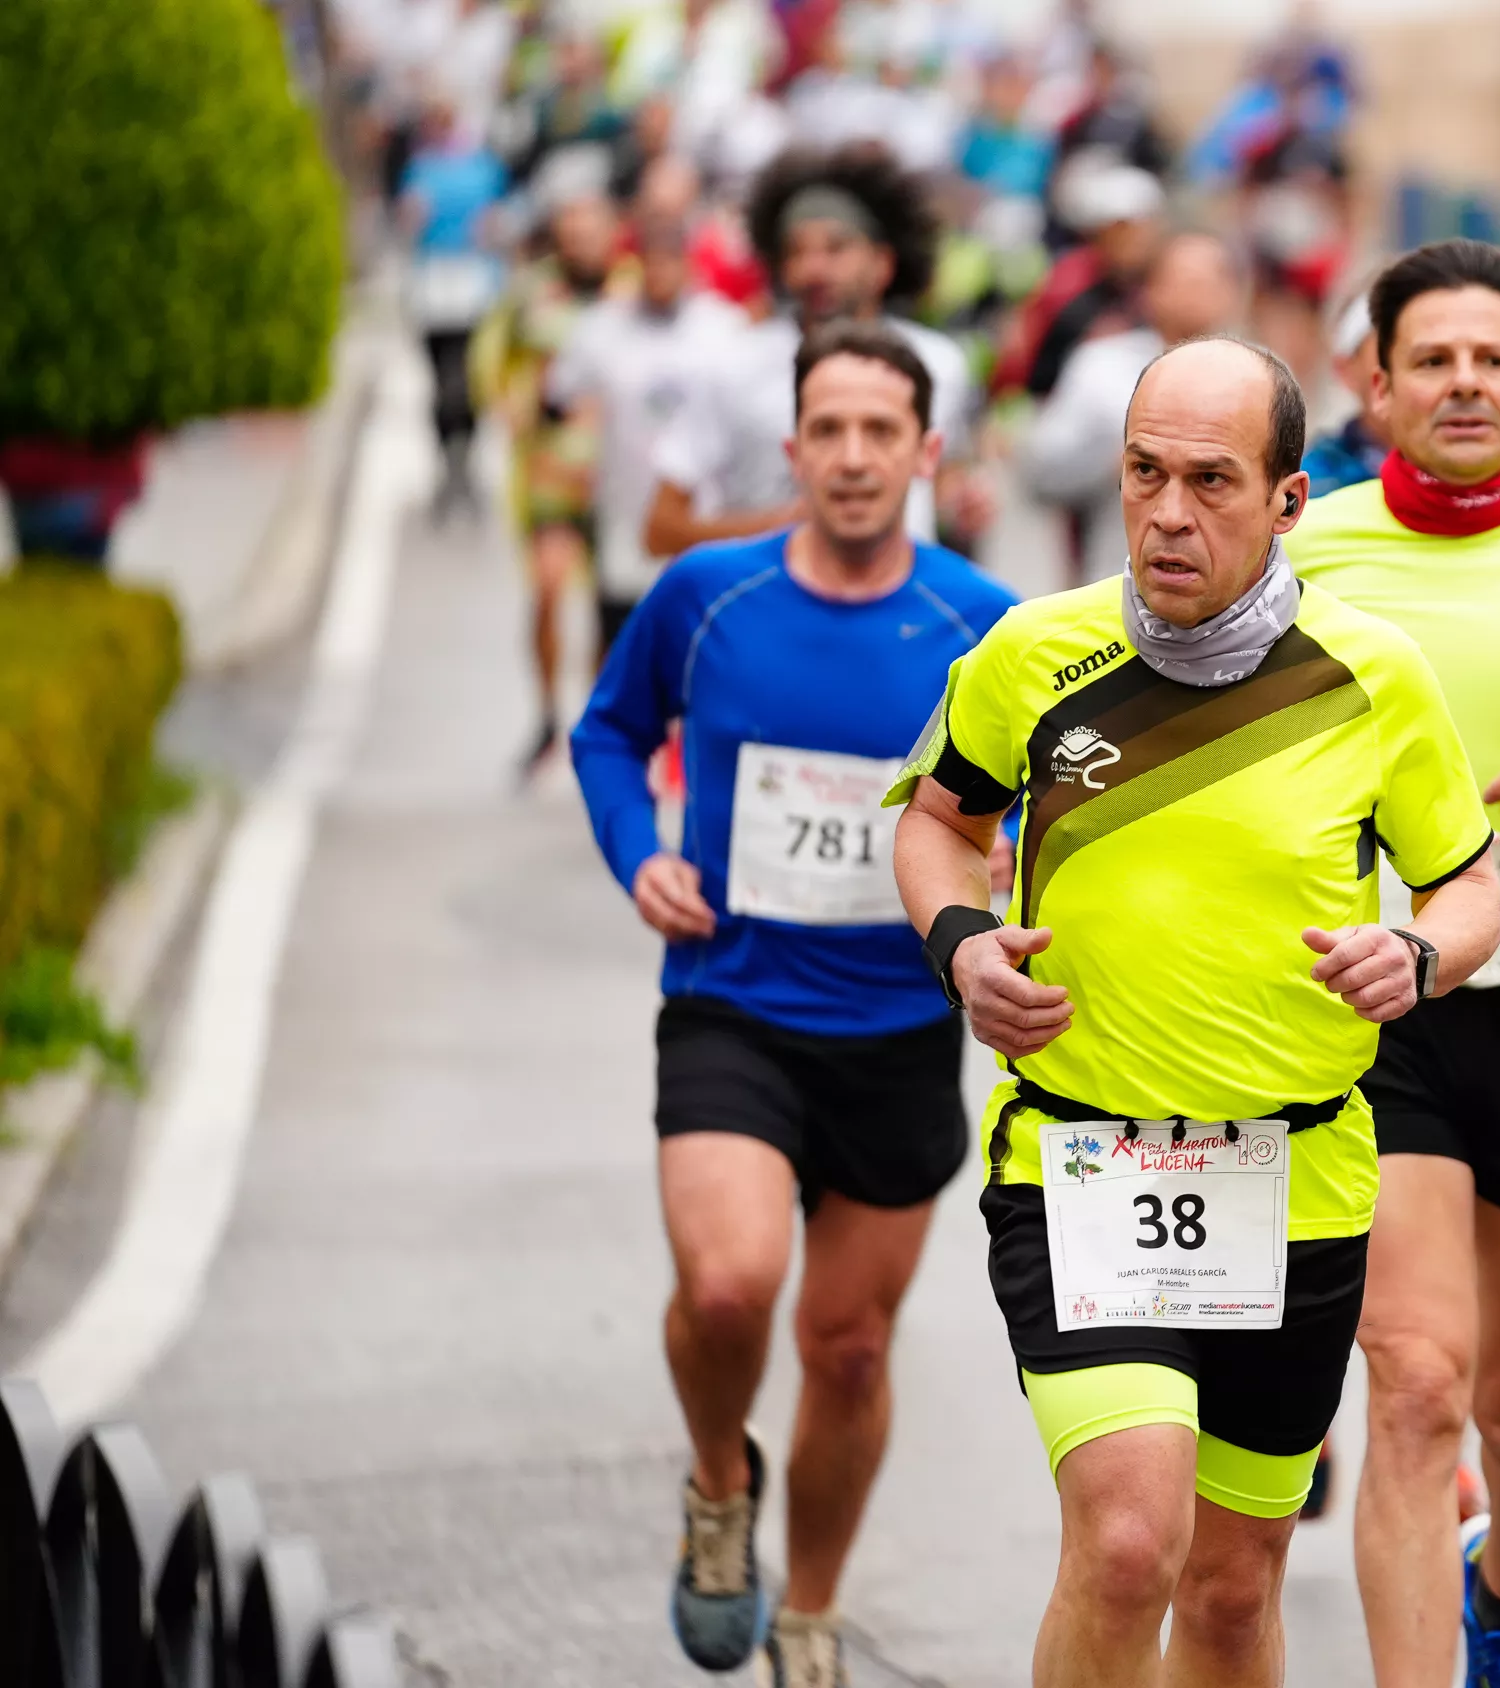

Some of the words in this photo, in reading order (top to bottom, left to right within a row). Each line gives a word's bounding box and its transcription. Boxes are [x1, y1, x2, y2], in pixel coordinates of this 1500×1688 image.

[786, 814, 876, 867] 781
[1111, 1134, 1134, 1158] X
[1140, 1153, 1216, 1172] LUCENA
[1133, 1193, 1206, 1250] 38
[1117, 1269, 1139, 1278] JUAN
[1141, 1267, 1168, 1277] CARLOS
[1169, 1268, 1196, 1276] AREALES
[1198, 1268, 1227, 1277] GARCÍA
[1157, 1279, 1190, 1288] M-Hombre
[1198, 1302, 1275, 1310] mediamaratonlucena.com
